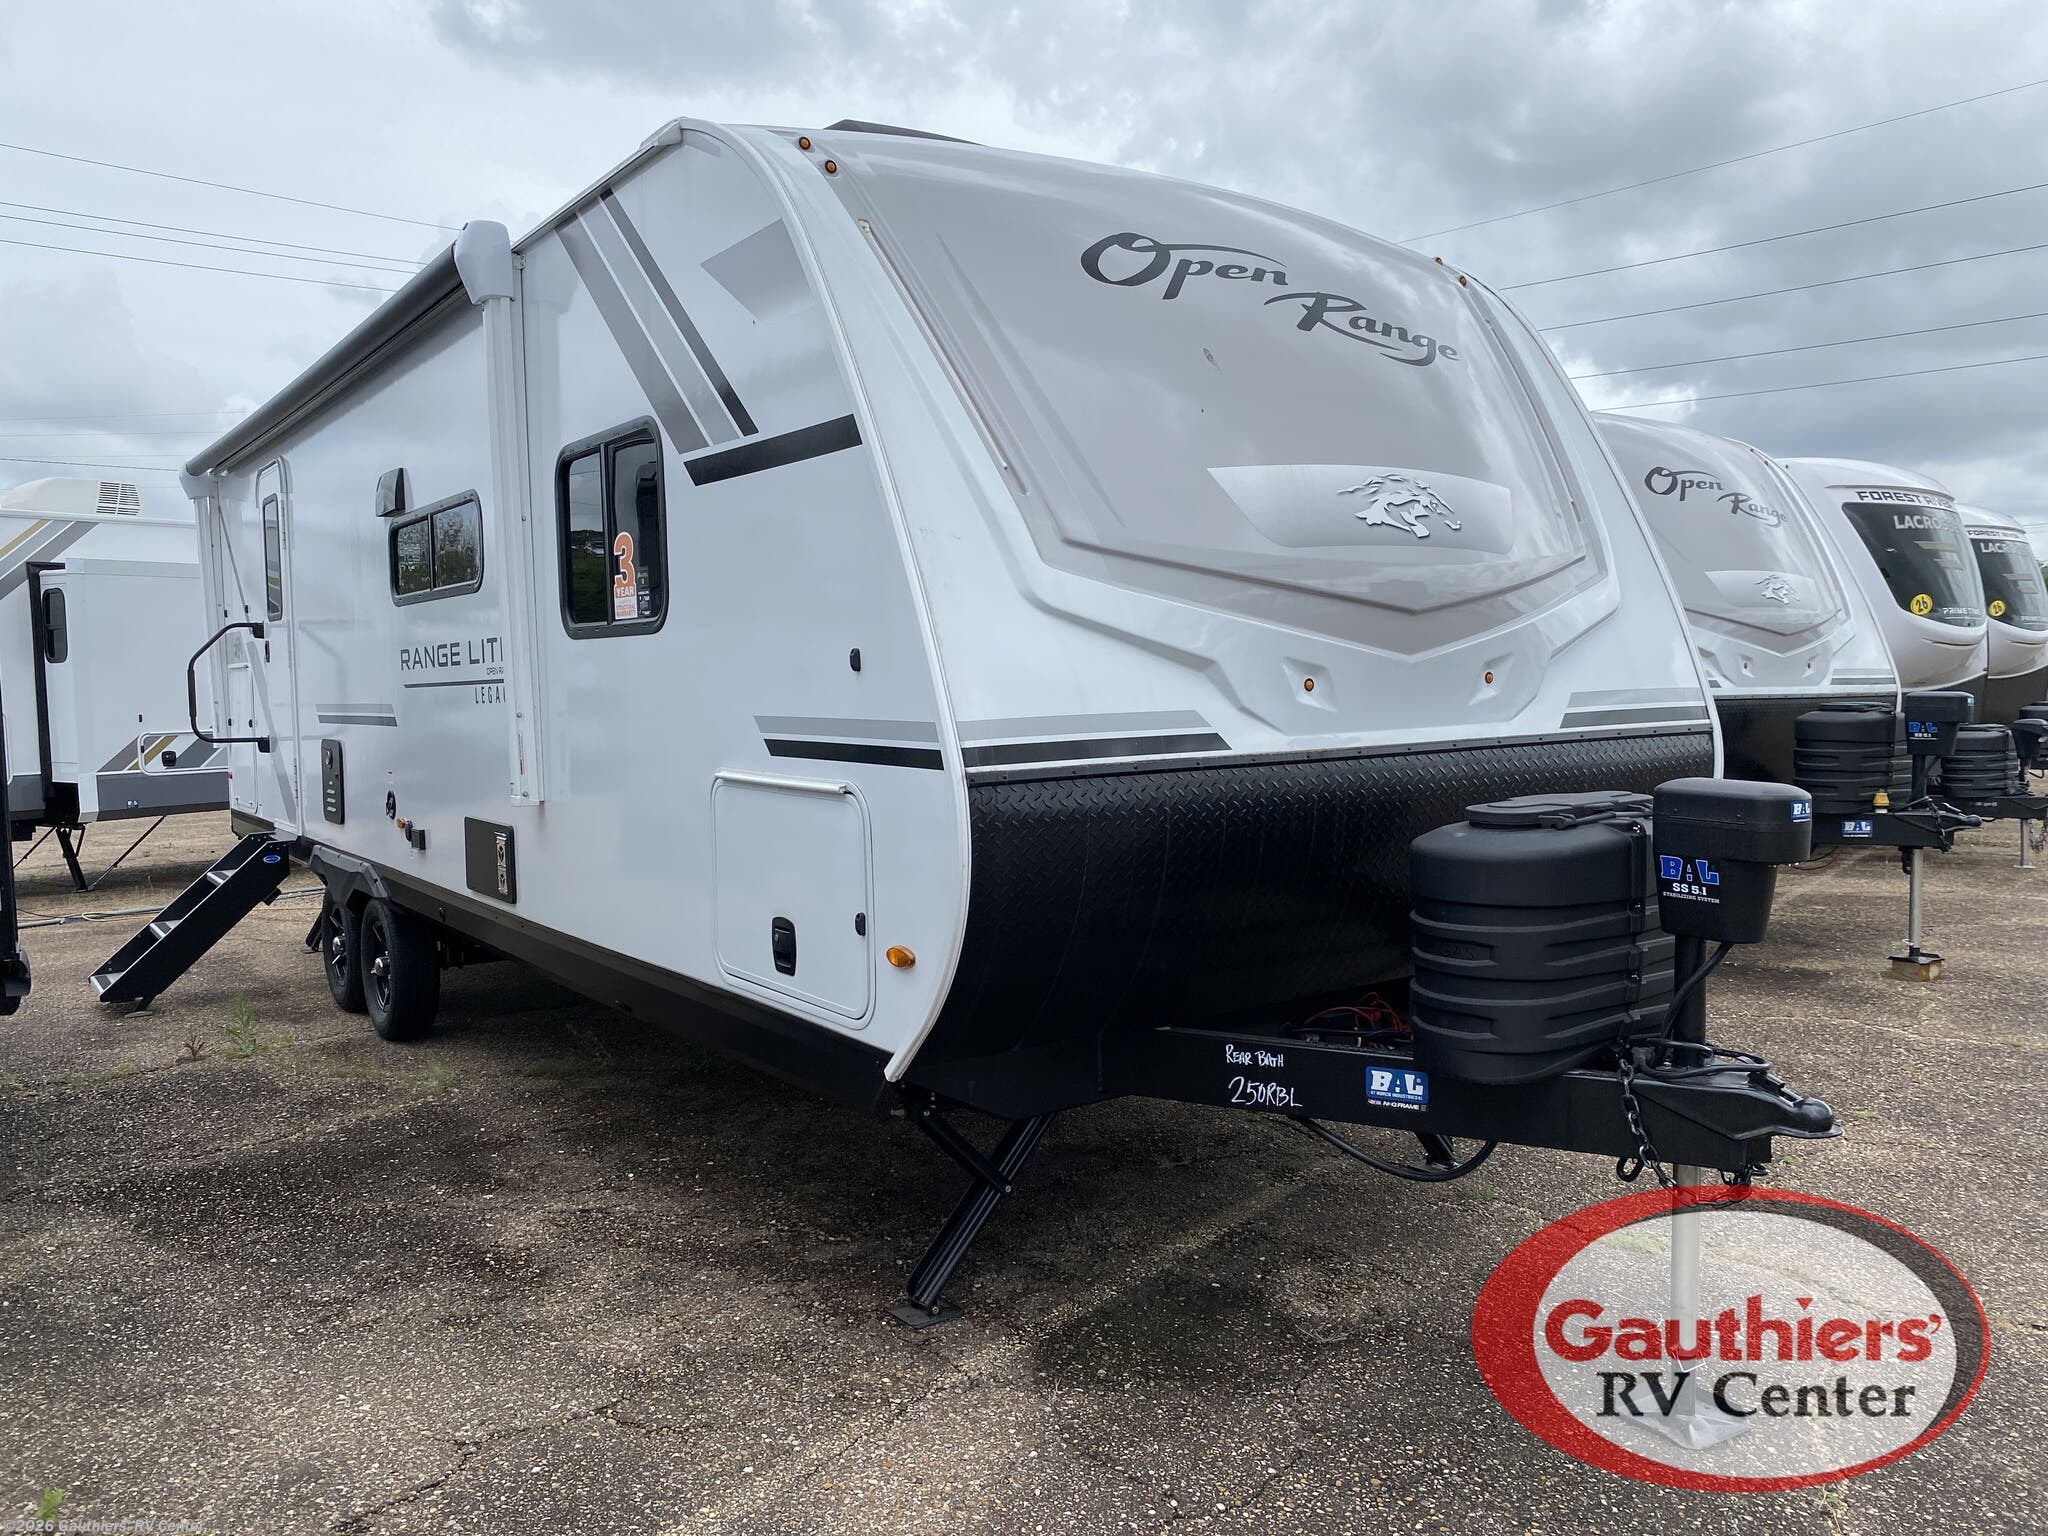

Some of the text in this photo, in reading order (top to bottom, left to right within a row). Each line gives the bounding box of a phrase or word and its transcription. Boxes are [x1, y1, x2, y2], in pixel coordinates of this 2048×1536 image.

[1081, 232, 1288, 300] Open
[1264, 292, 1460, 366] Range
[1644, 466, 1724, 501] Open
[1856, 491, 1921, 504] FOREST
[1717, 492, 1788, 528] Range
[614, 532, 636, 585] 3
[616, 586, 635, 597] YEAR
[1915, 596, 1928, 613] 26
[400, 637, 503, 671] RANGE LIT
[475, 686, 506, 704] LEGA
[1672, 882, 1707, 896] SS 5.1
[1225, 1044, 1253, 1065] REAR
[1228, 1076, 1303, 1107] 250RBL
